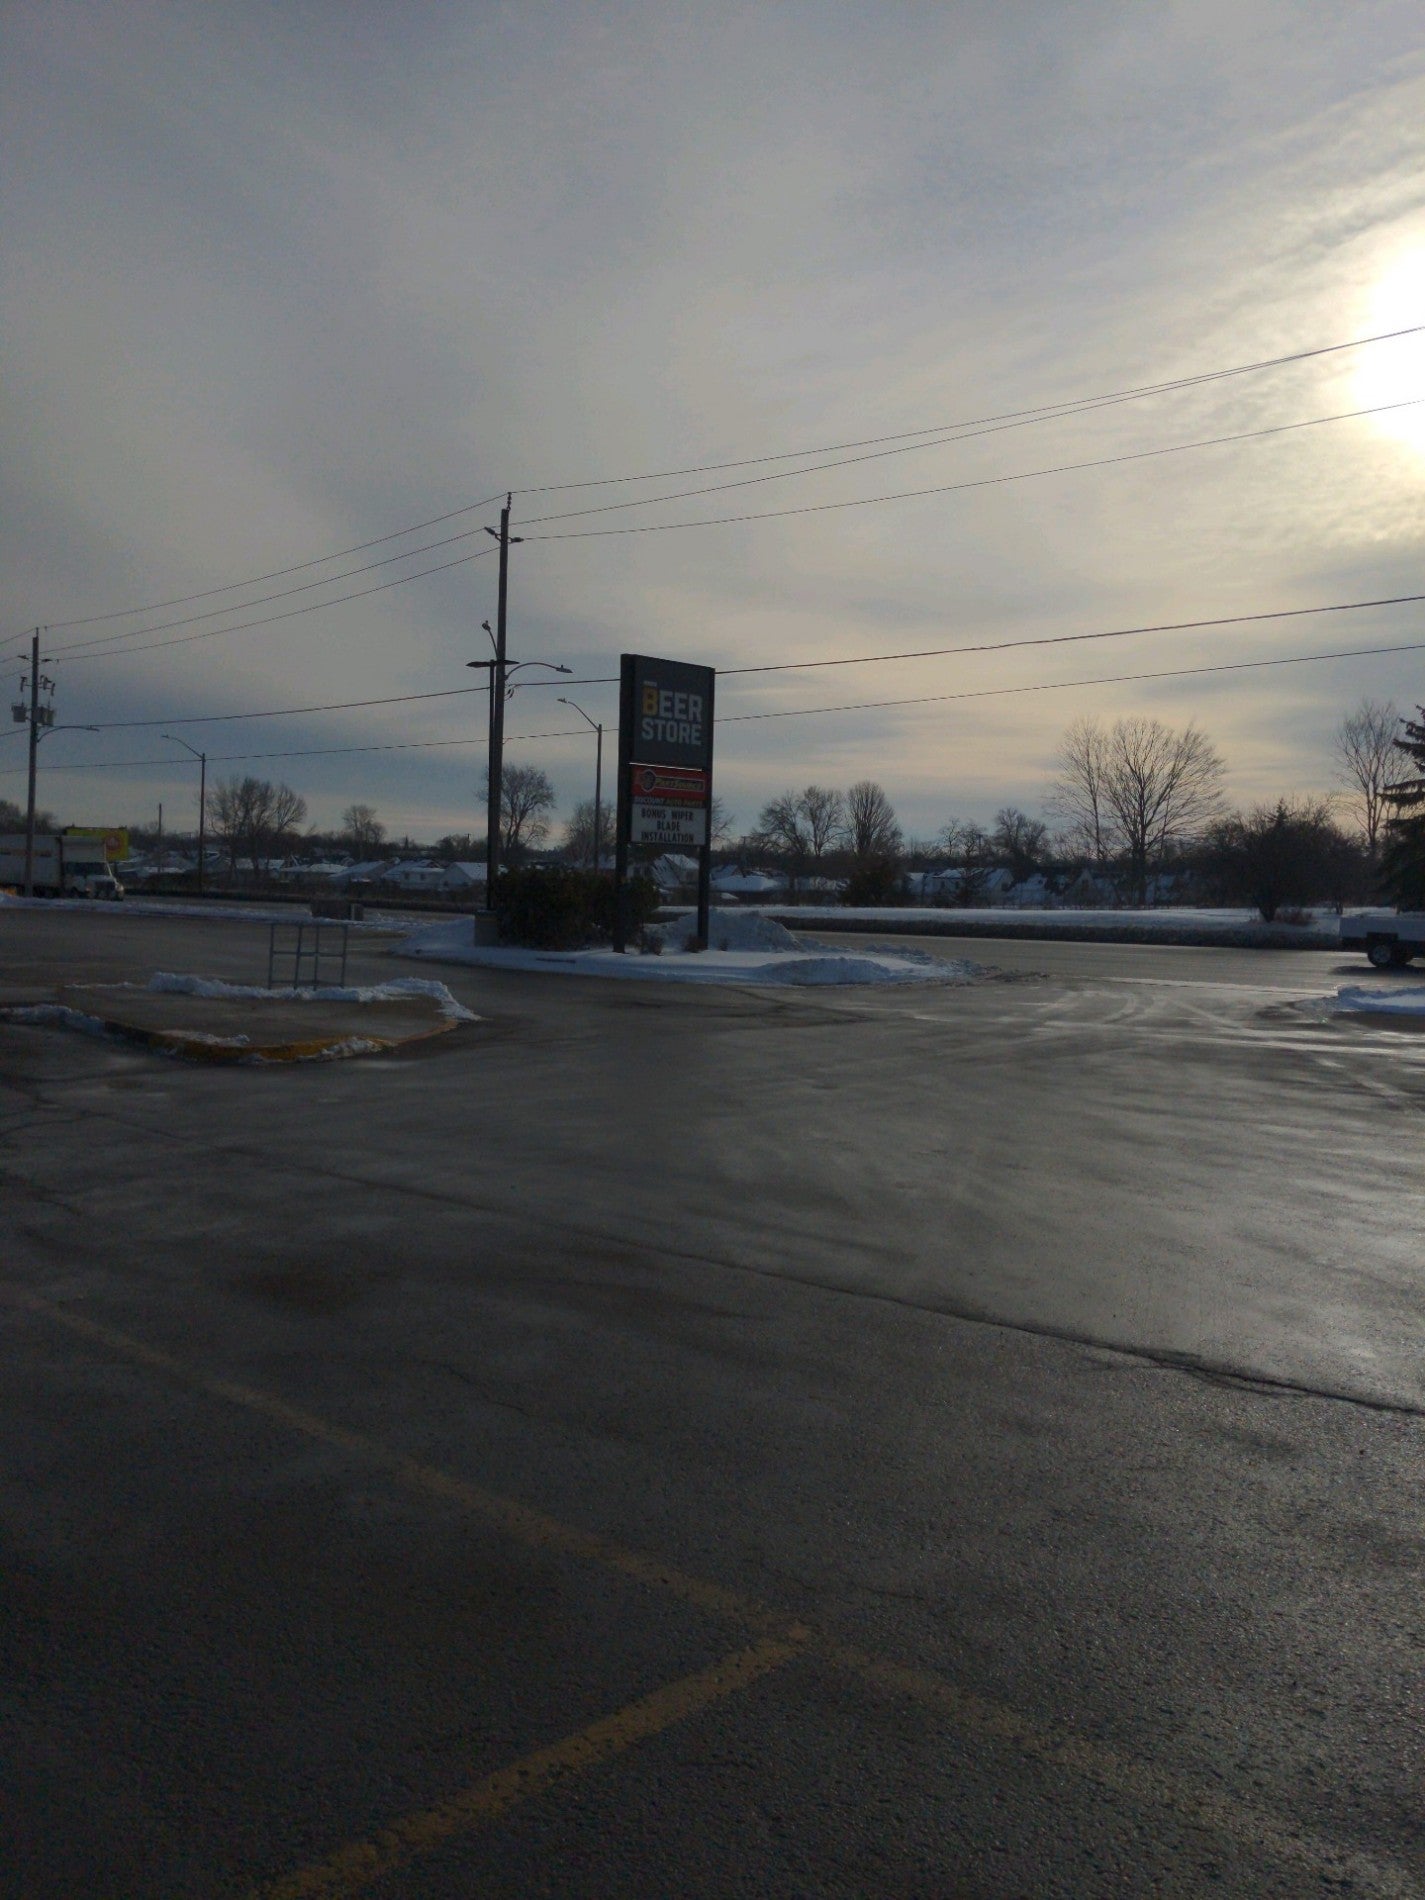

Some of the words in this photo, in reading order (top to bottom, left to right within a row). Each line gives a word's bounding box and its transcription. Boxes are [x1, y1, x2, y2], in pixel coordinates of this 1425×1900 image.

[642, 686, 702, 722] BEER
[641, 718, 702, 745] STORE
[641, 808, 666, 819] BONUS
[671, 810, 694, 821] WIPER
[656, 820, 681, 831] BLADE
[641, 831, 695, 843] INSTALLATION
